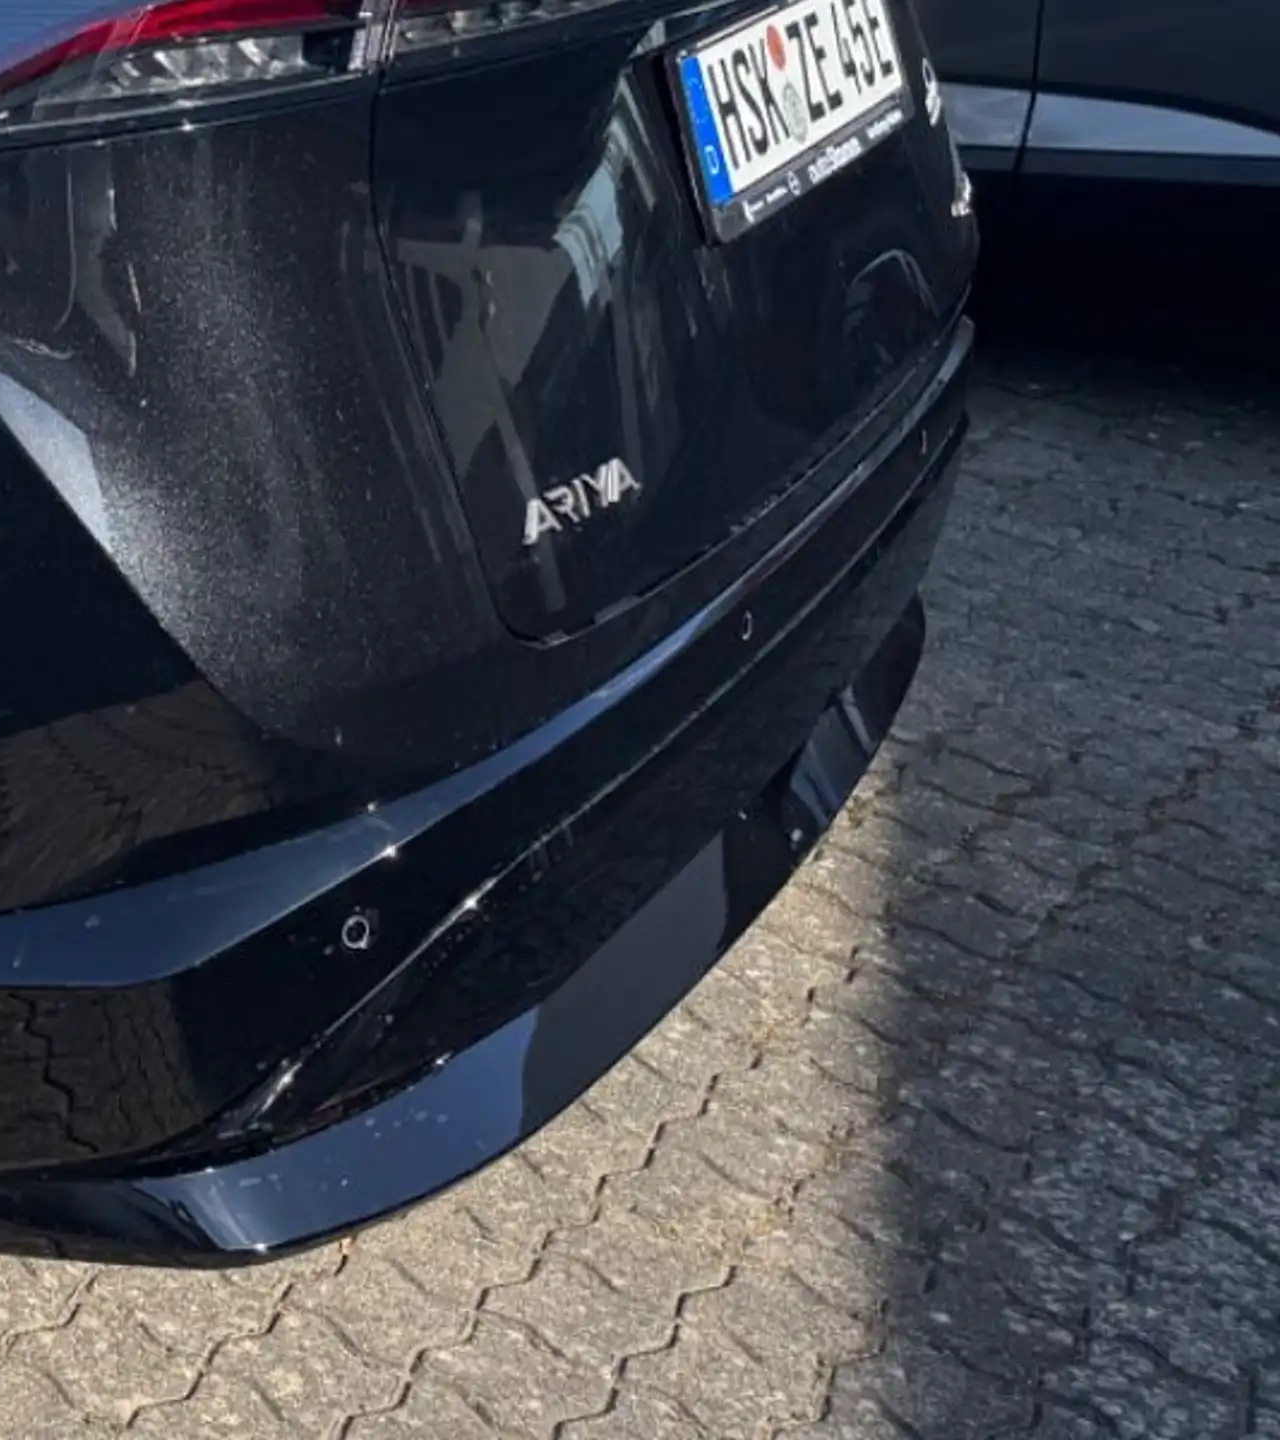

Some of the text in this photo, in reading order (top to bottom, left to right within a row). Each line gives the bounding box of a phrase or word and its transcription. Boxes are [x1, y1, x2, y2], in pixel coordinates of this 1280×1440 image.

[707, 38, 791, 170] HSK
[785, 11, 843, 122] ZE
[704, 144, 719, 175] D
[522, 457, 641, 546] ARIYA
